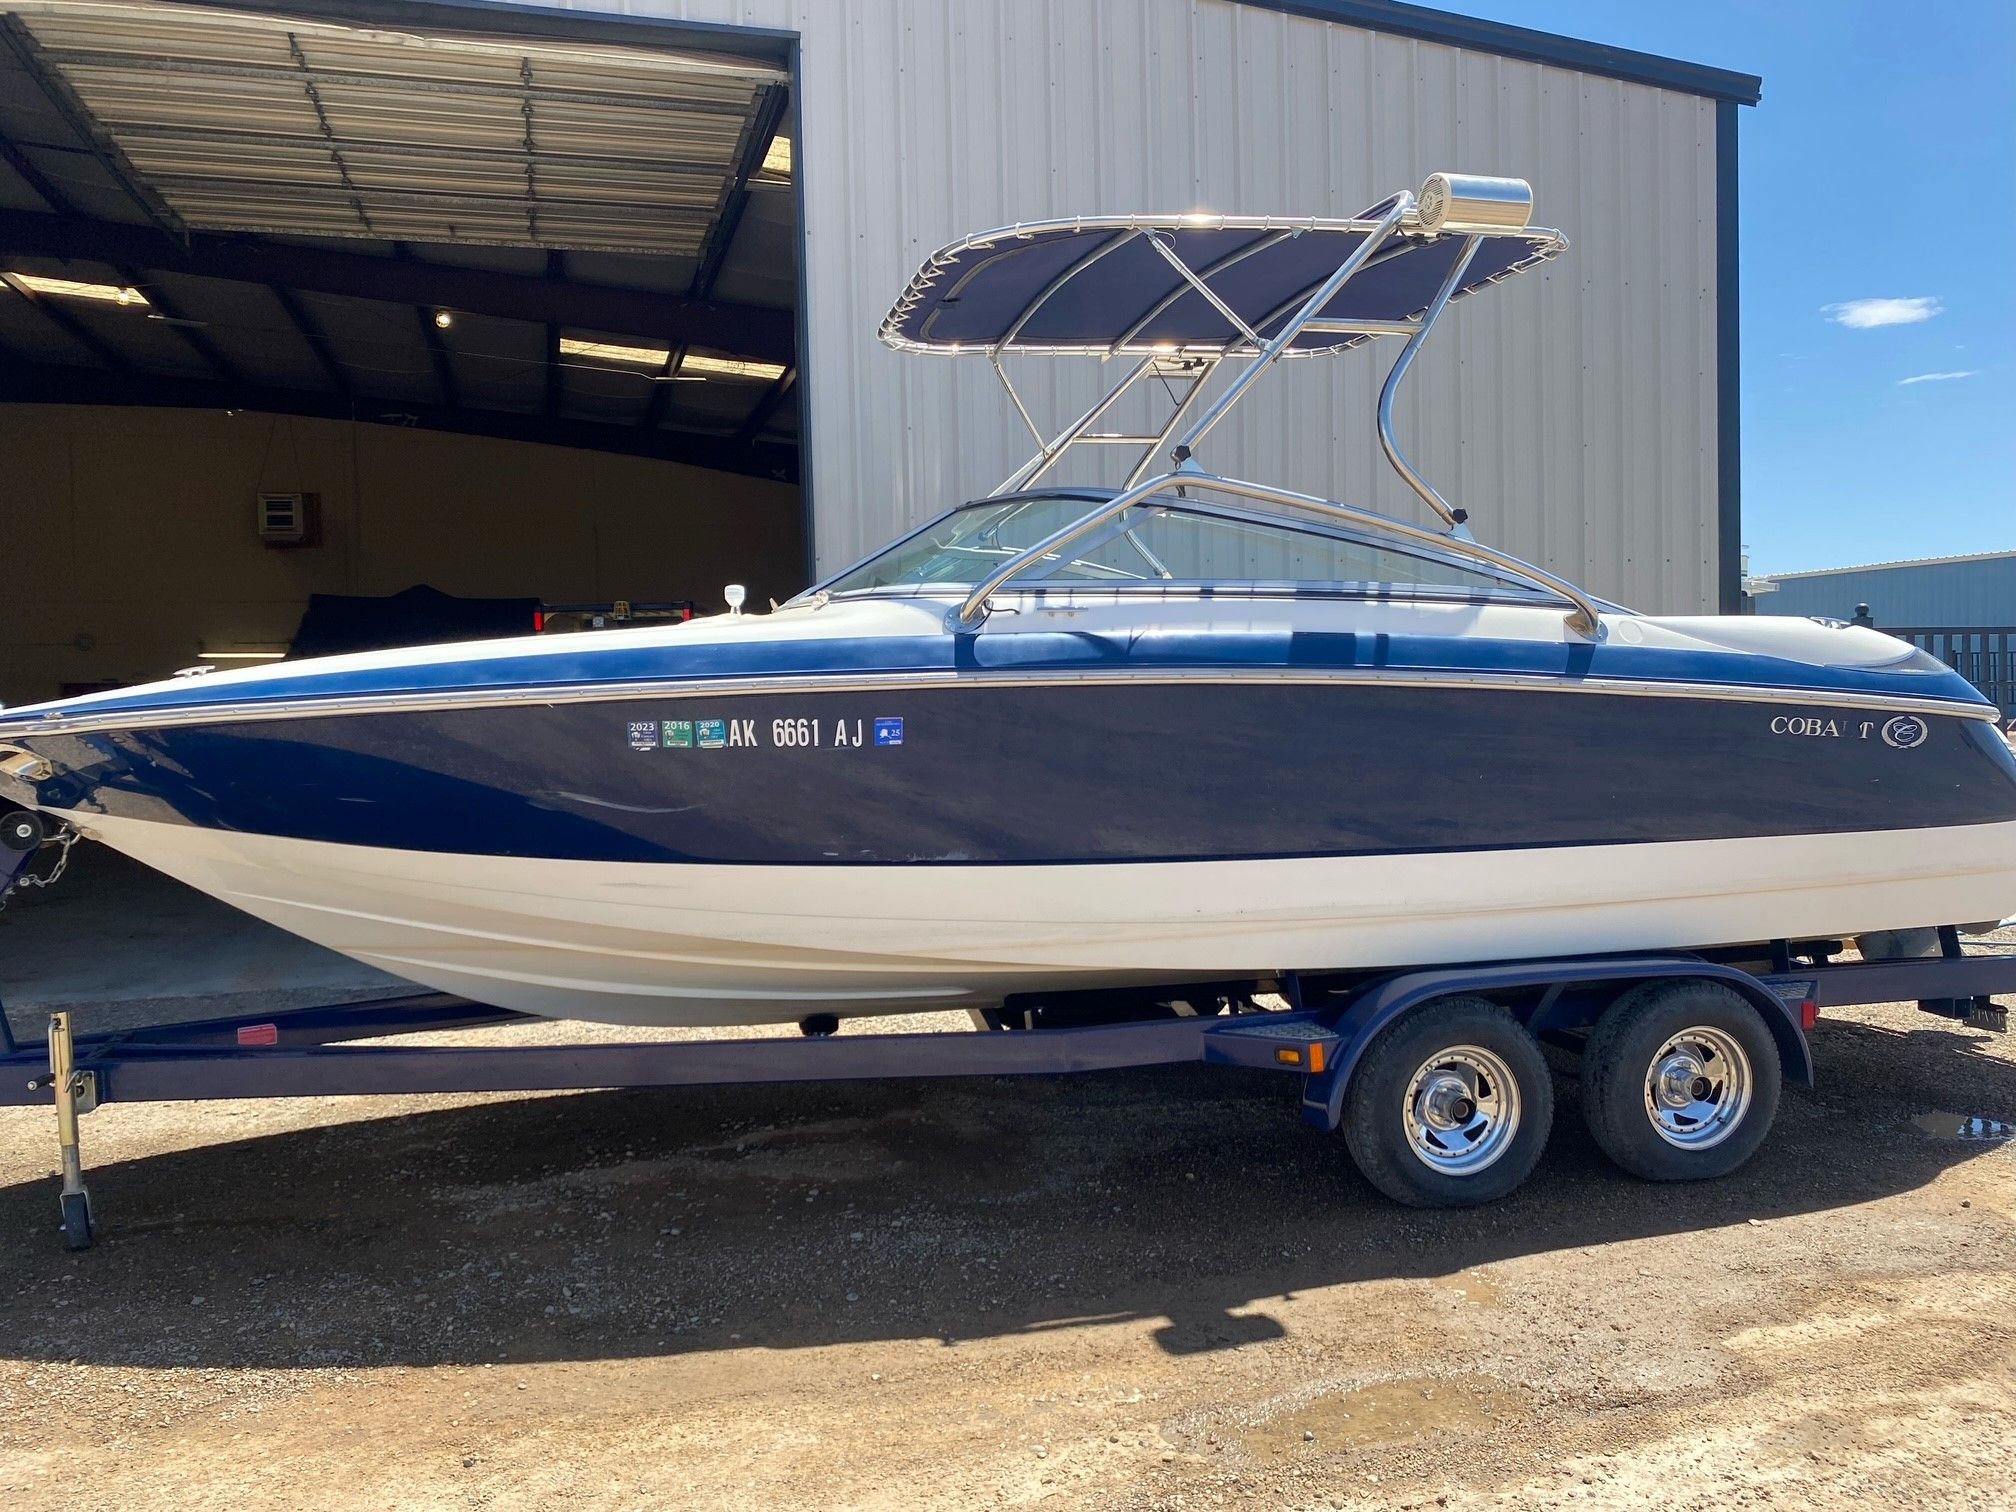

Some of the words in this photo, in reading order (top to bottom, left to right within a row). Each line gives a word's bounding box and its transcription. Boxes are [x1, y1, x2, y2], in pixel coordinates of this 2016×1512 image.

[630, 722, 655, 732] 2023
[664, 721, 690, 731] 2016
[699, 721, 720, 729] 2020
[1770, 716, 1874, 739] COBAT
[729, 719, 758, 747] AK
[772, 718, 819, 747] 6661
[891, 729, 901, 737] 25
